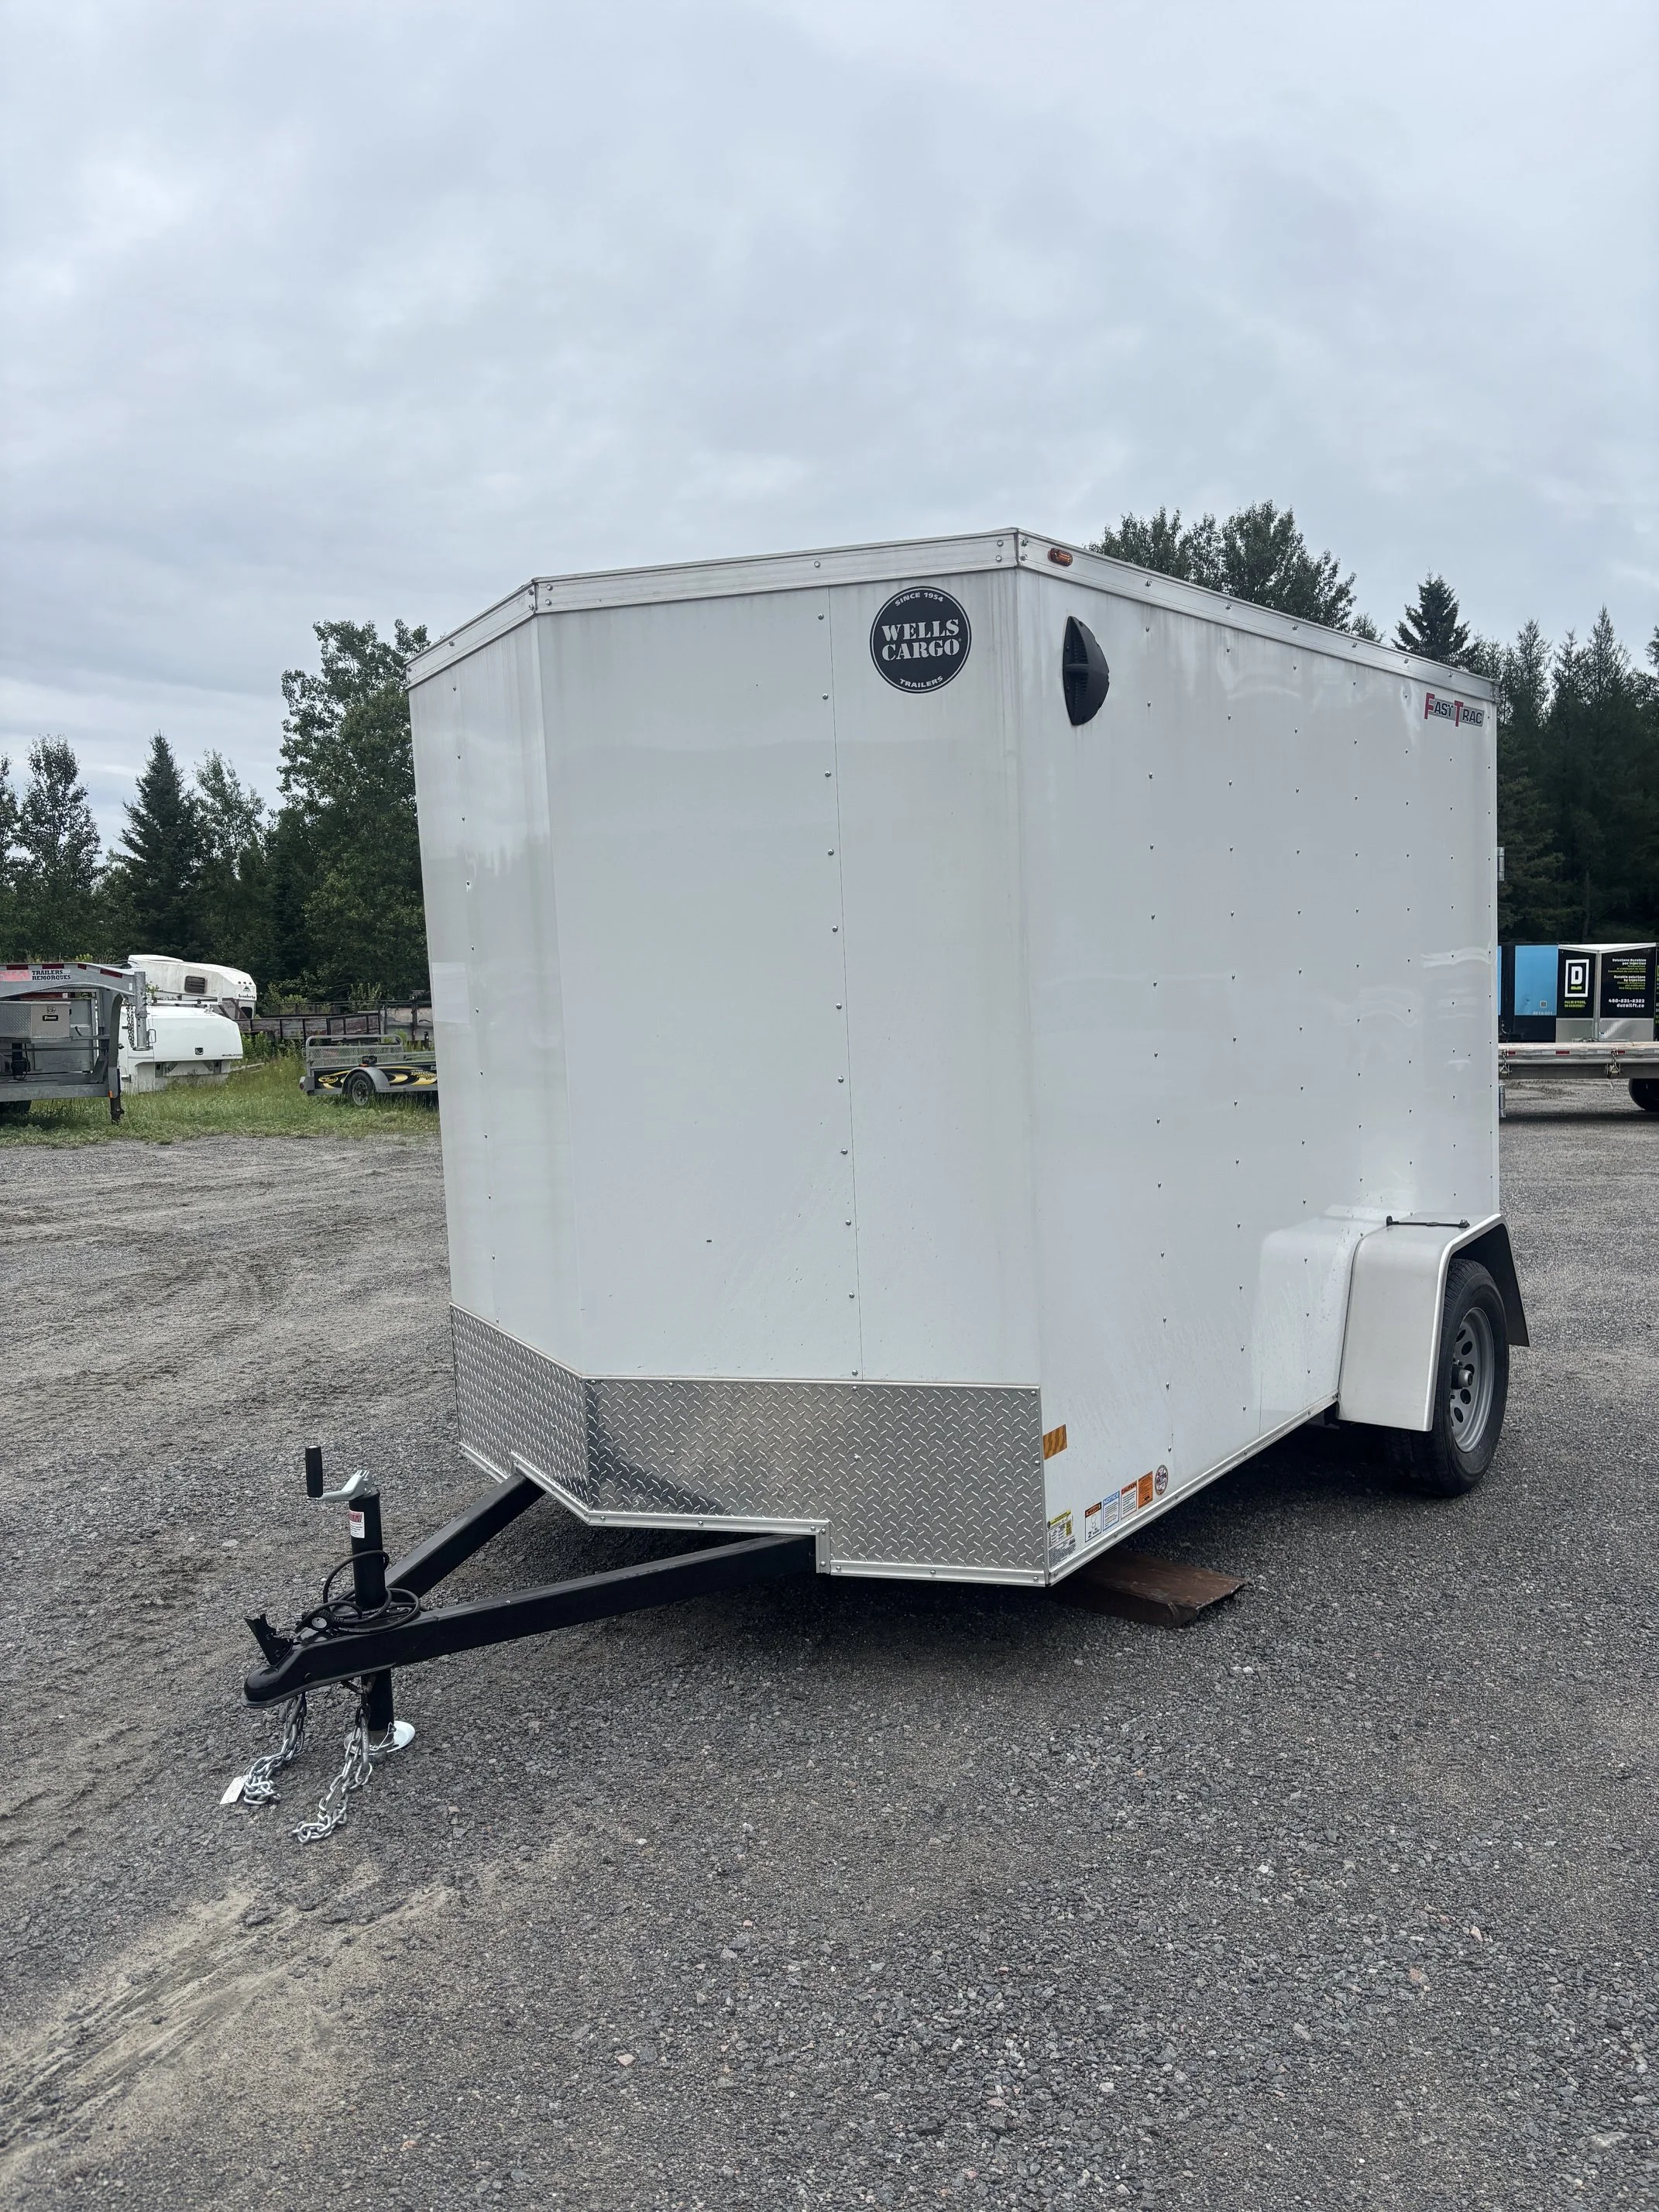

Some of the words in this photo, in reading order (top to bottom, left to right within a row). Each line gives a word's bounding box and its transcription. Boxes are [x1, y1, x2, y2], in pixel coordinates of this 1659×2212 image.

[895, 592, 921, 606] SINCE
[923, 592, 944, 603] 1954
[881, 619, 960, 641] WELLS
[881, 638, 960, 661] CARGO
[899, 675, 943, 688] TRAILERS
[1571, 966, 1583, 985] D
